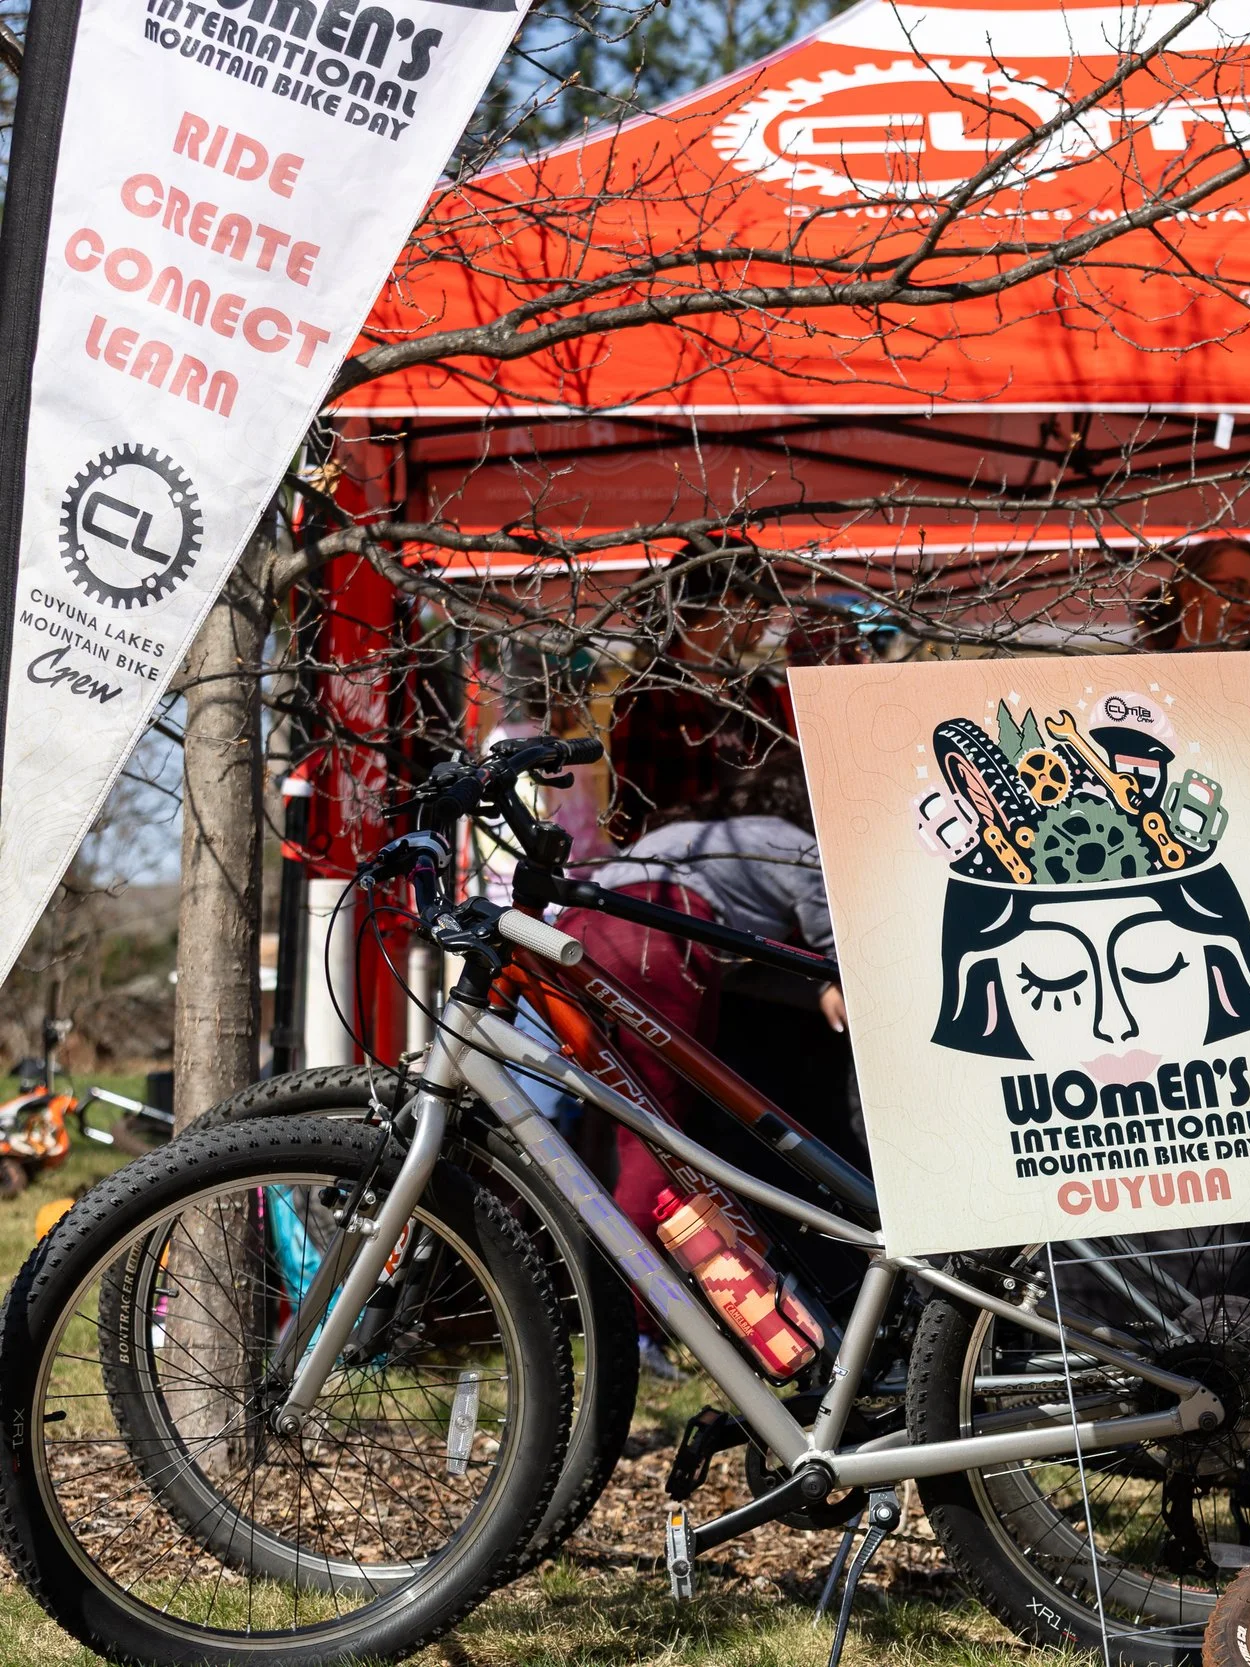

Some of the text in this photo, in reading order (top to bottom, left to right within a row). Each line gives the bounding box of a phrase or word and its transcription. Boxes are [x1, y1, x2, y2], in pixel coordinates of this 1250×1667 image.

[147, 0, 418, 118] INTERNATIONAL
[215, 0, 443, 81] MEN'S
[144, 17, 410, 142] MOUNTAIN BIKE DAY
[172, 111, 305, 199] RIDE
[120, 172, 322, 288] CREATE
[63, 228, 331, 369] CONNECT
[84, 314, 239, 419] LEARN
[82, 491, 172, 566] CL
[19, 610, 160, 682] MOUNTAIN BIKE
[30, 588, 165, 658] CUYUNA LAKES
[26, 644, 123, 704] Crew
[585, 978, 671, 1046] 820
[1000, 1056, 1250, 1126] WOMEN'S
[1015, 1148, 1149, 1178] MOUNTAIN
[1154, 1142, 1210, 1165] BIKE
[1057, 1167, 1232, 1216] CUYUNA
[119, 1275, 135, 1364] BONTRAGER
[725, 1303, 755, 1337] CAMELBAK
[13, 1408, 25, 1450] XR1
[1026, 1596, 1061, 1631] XR1
